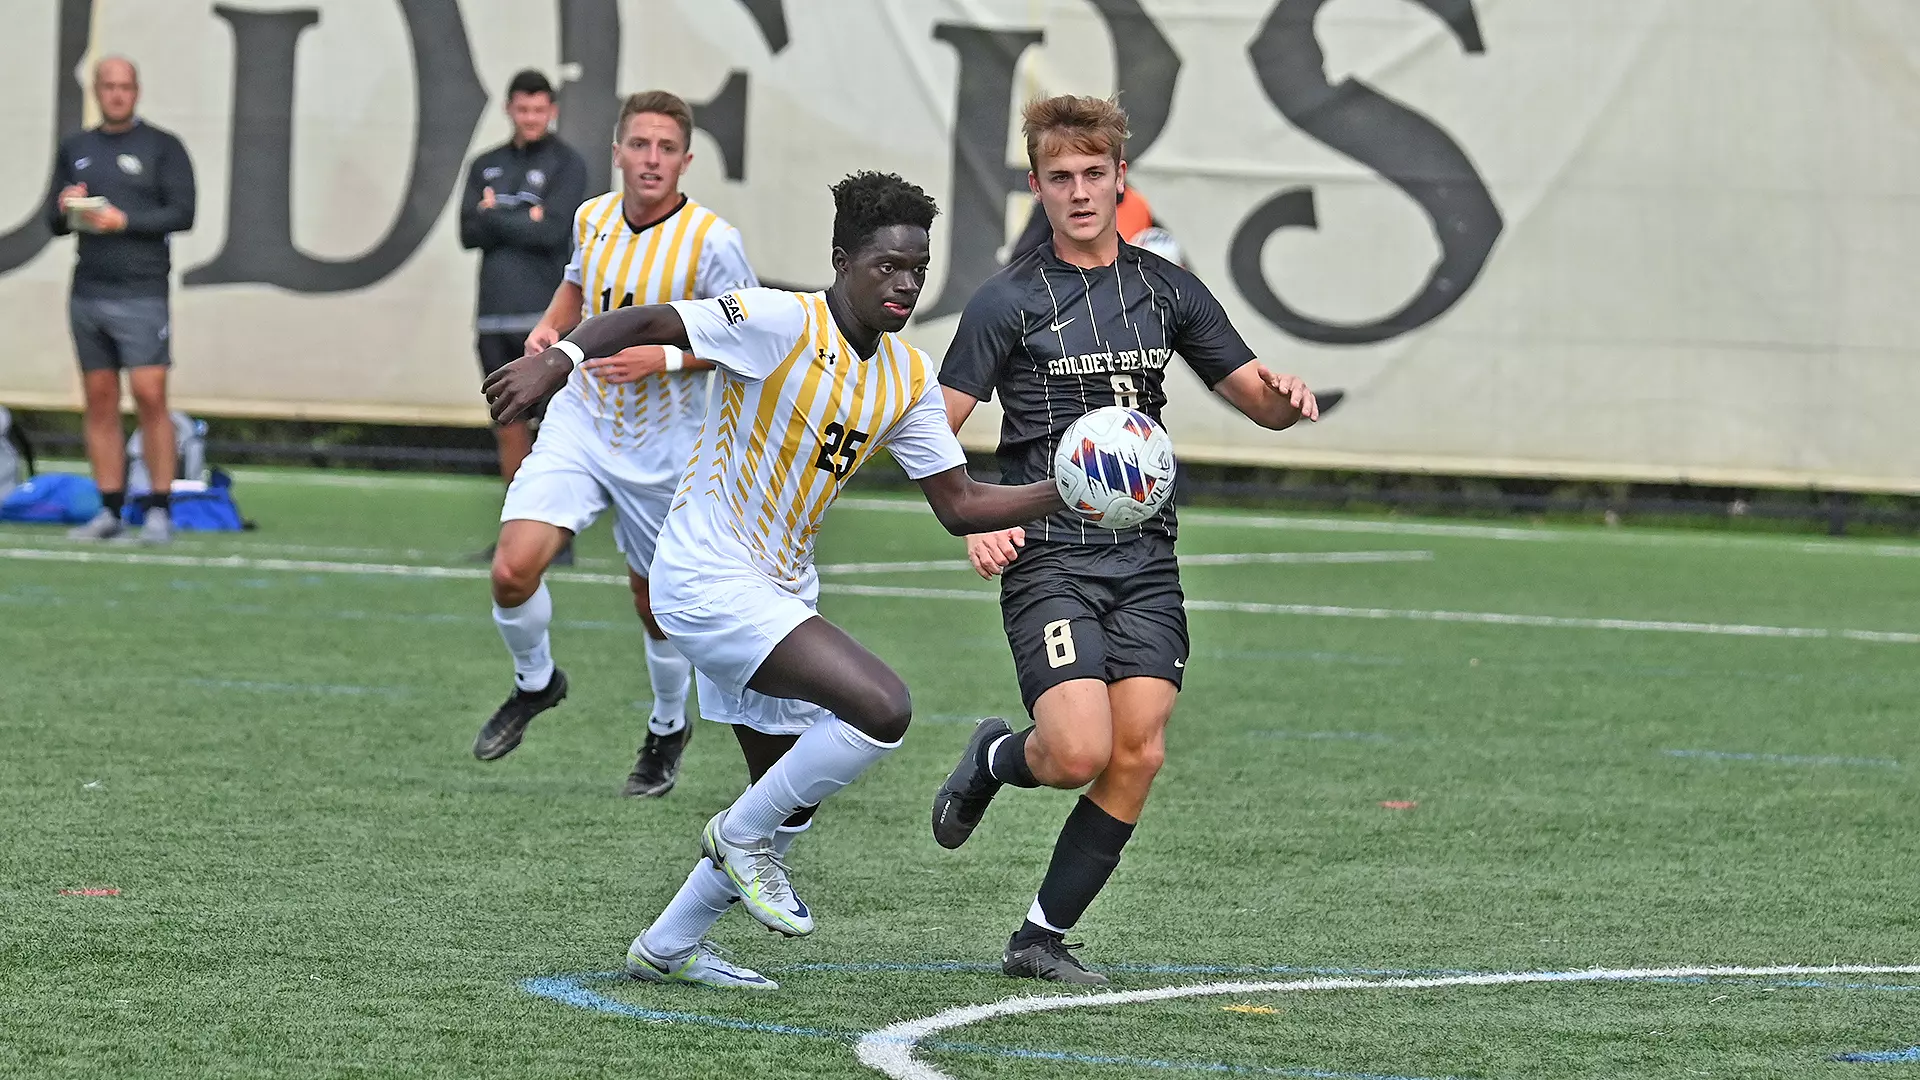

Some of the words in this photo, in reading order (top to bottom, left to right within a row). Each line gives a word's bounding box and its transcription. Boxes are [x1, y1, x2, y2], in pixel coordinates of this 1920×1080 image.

[1110, 374, 1139, 409] 8
[815, 421, 869, 481] 25
[1043, 619, 1076, 668] 8
